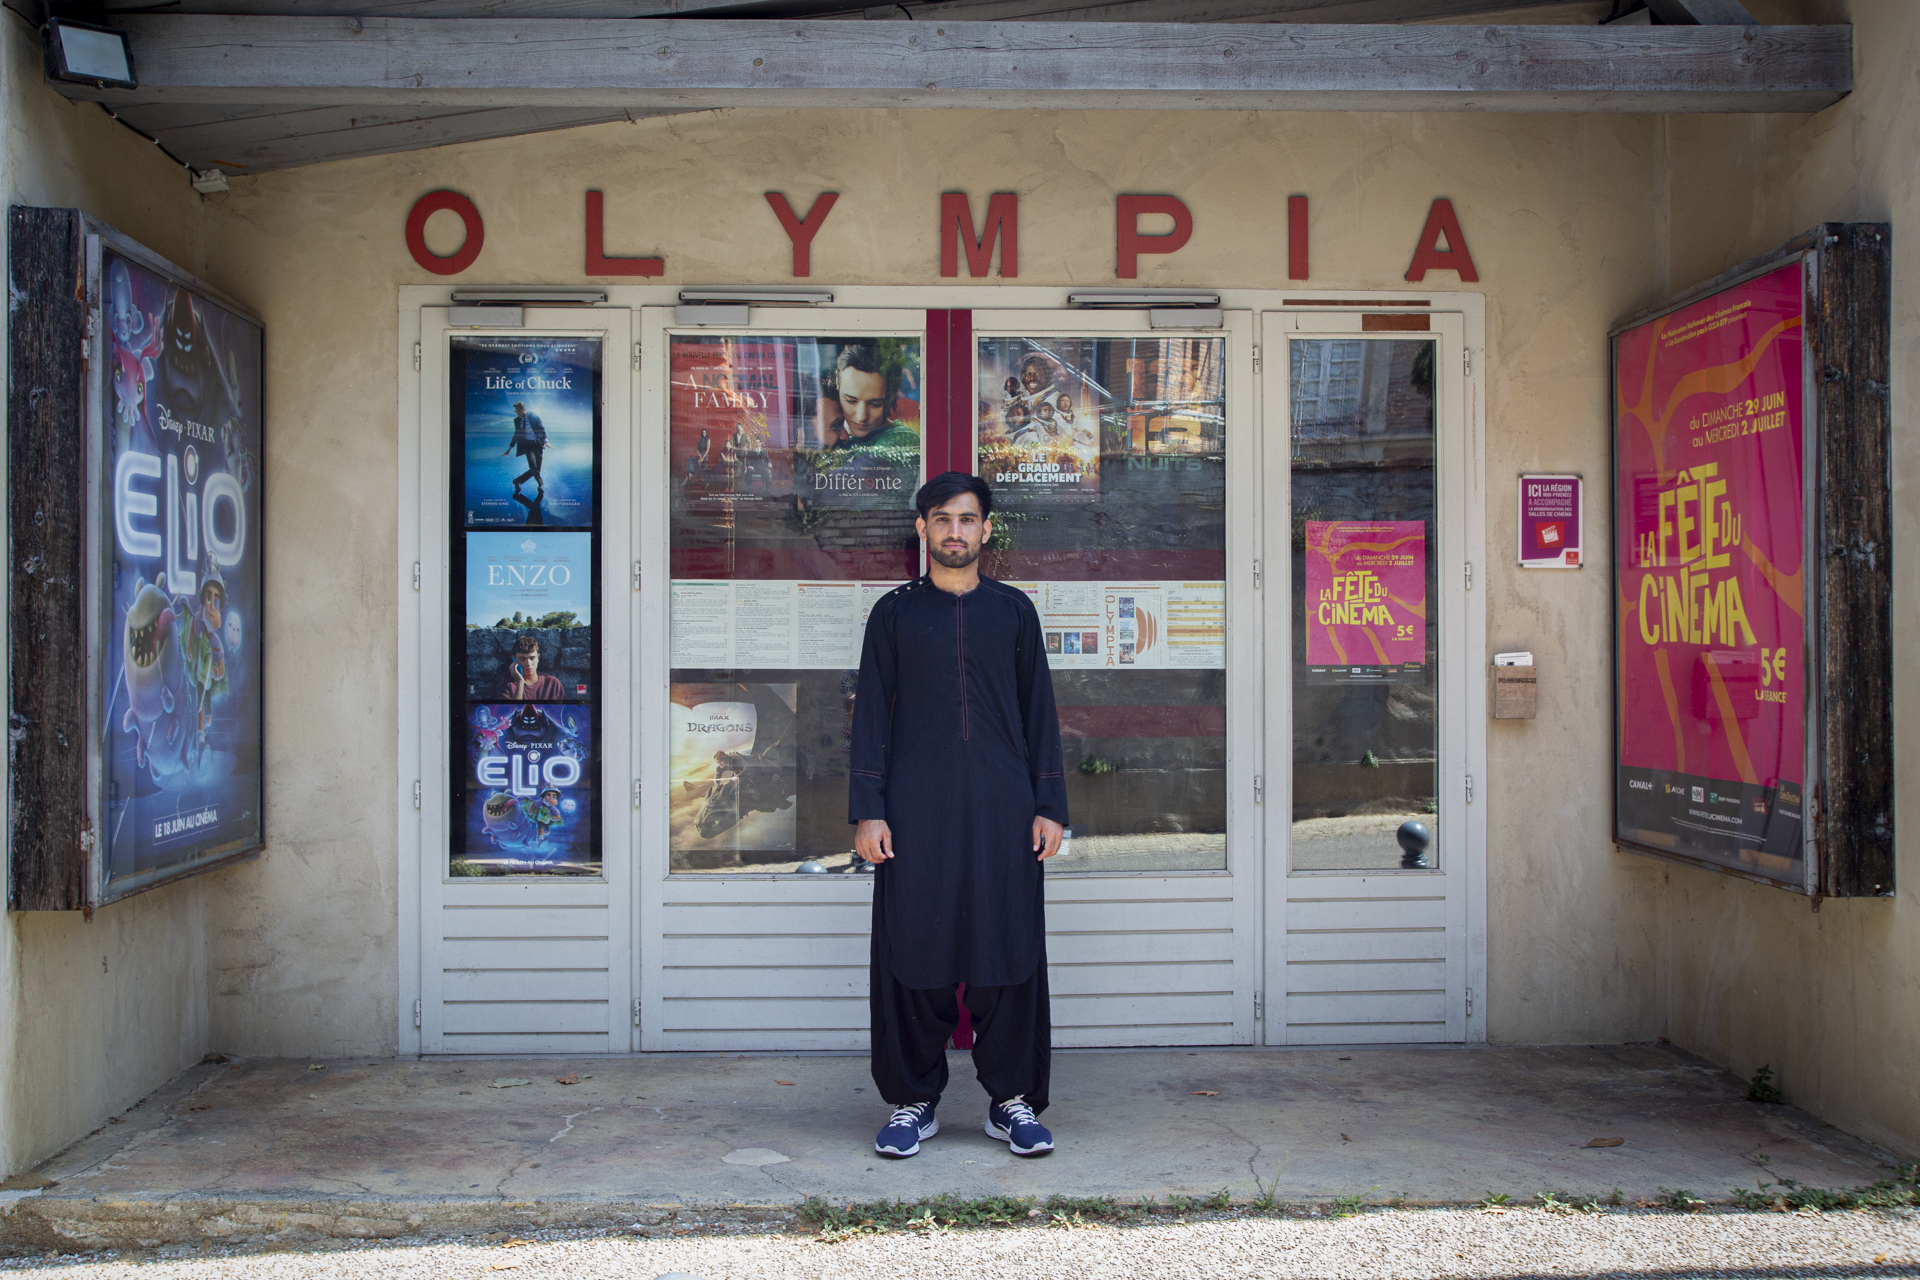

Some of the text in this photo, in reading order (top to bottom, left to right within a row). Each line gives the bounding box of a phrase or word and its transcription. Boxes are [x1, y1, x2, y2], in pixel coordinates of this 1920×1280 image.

[405, 189, 1480, 283] OLYMPIA
[486, 376, 572, 390] Life of Chuck
[684, 374, 778, 390] A NORMAL
[694, 392, 772, 408] FAMILY
[1690, 391, 1784, 430] du DIMANCHE 29 JUIN
[186, 420, 216, 444] PIXAR
[1692, 411, 1786, 448] au MERCREDI 2 JUILLET
[1032, 453, 1046, 462] LE
[1128, 457, 1202, 470] NUITS
[1018, 463, 1060, 472] GRAND
[815, 472, 902, 490] Différente
[996, 470, 1082, 482] DÉPLACEMENT
[1528, 484, 1542, 498] ICI
[1550, 483, 1572, 492] RÉGION
[1534, 498, 1572, 506] ACCOMPAGNÉ
[1640, 462, 1741, 570] LA FÊTE DU
[487, 564, 570, 586] ENZO
[1320, 570, 1388, 602] LA FÊTE DU
[1104, 595, 1116, 666] OLYMPIA
[686, 722, 753, 734] DRAGONS
[1629, 780, 1653, 790] CANAL+
[155, 807, 218, 838] LE 18 JUIN AU CINÉMA
